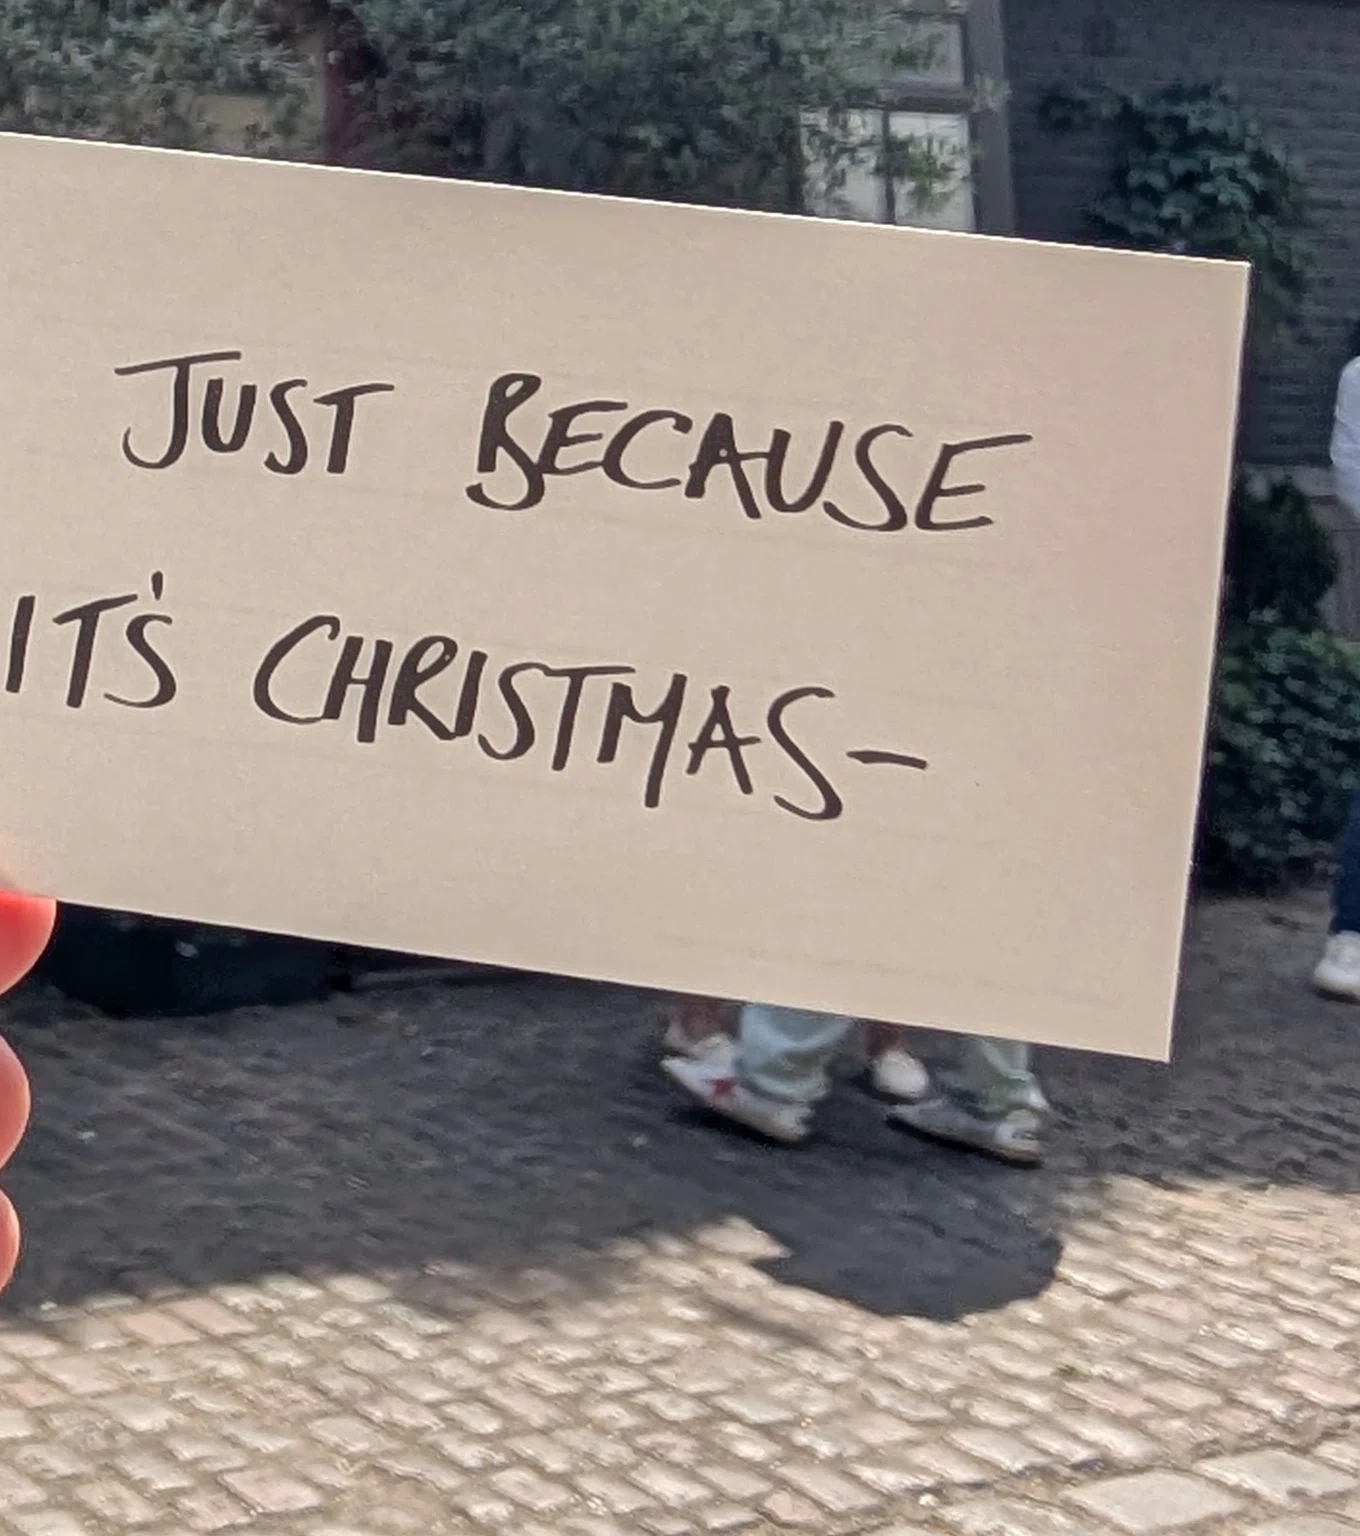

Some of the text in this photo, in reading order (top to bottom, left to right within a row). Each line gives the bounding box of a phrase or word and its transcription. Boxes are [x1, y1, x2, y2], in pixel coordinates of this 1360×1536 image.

[114, 351, 1033, 532] JUST BECAUSE
[5, 571, 177, 709] IT'S
